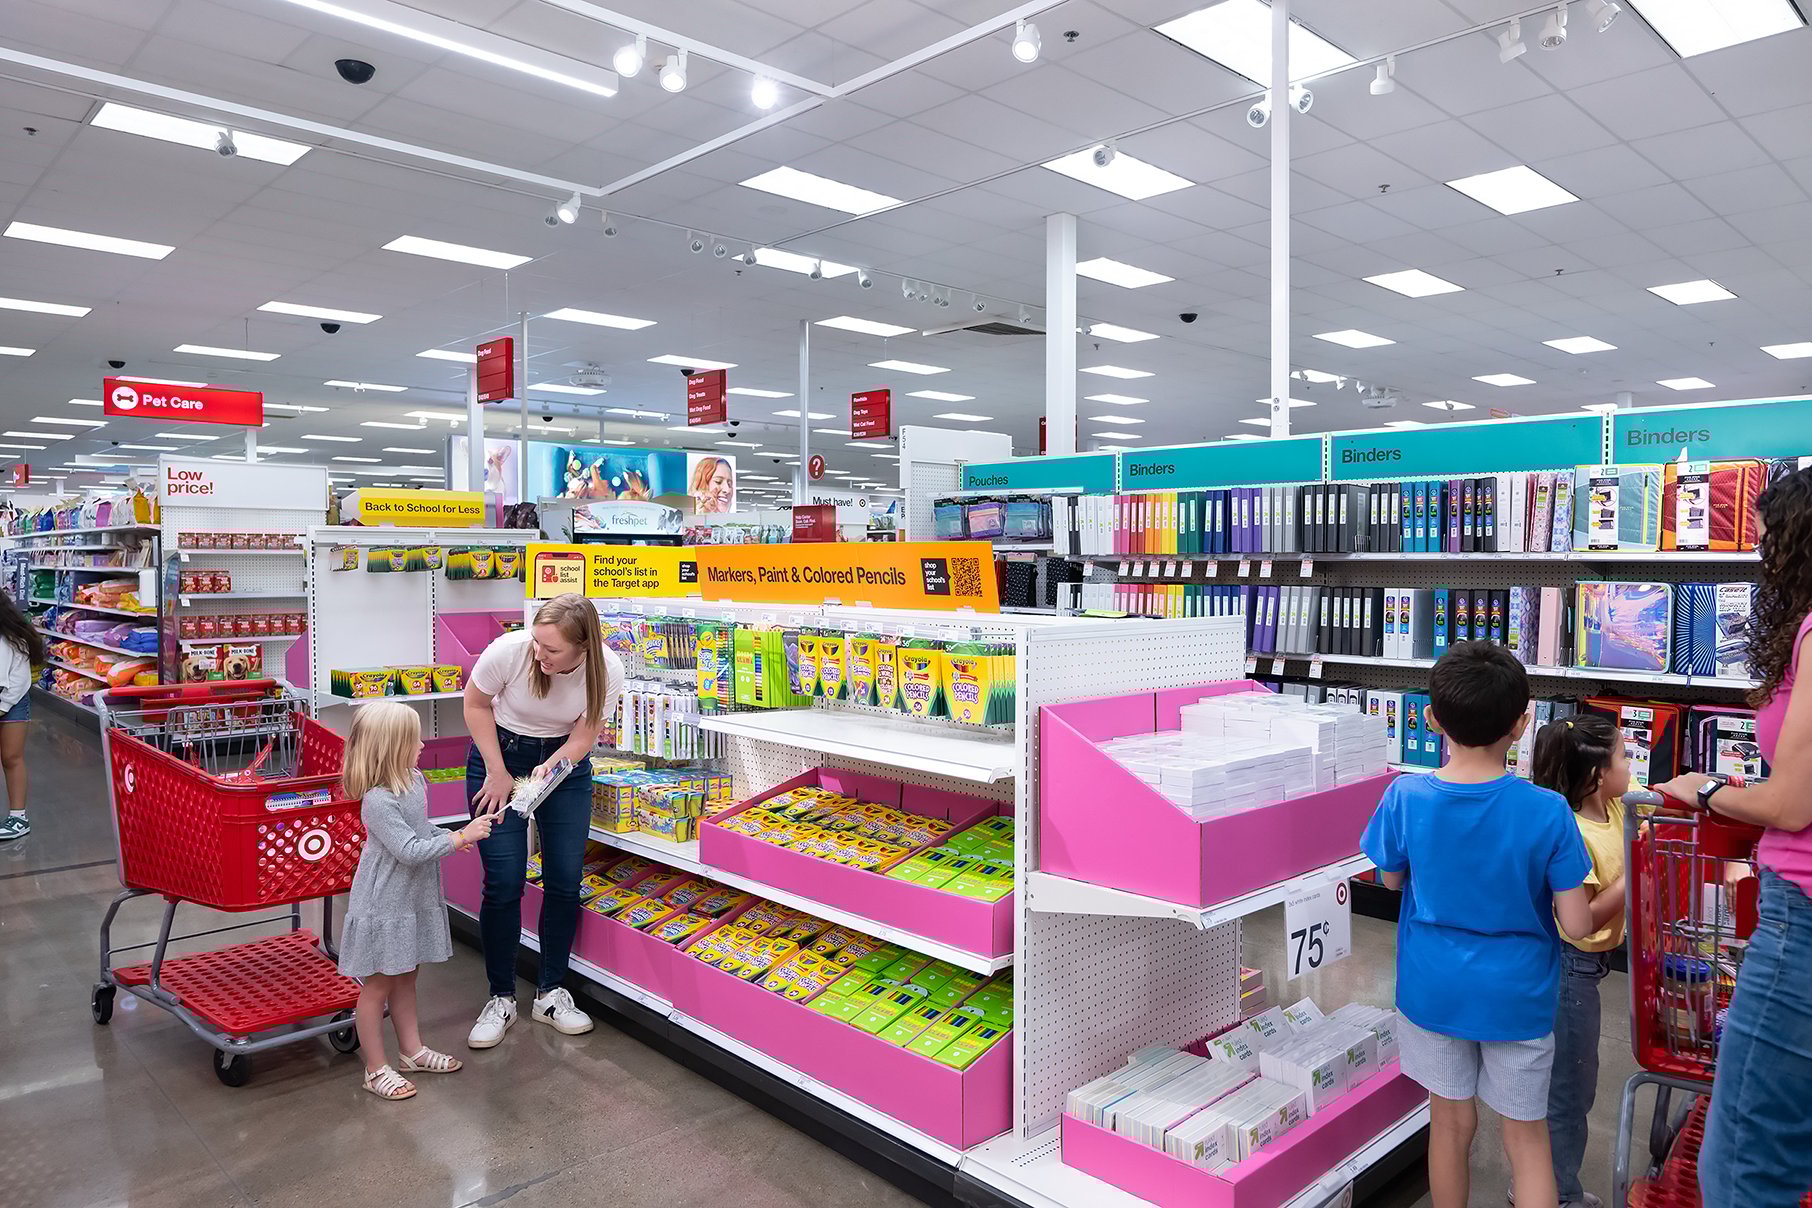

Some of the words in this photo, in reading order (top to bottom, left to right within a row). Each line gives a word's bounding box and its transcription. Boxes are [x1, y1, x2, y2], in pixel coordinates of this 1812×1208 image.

[143, 394, 167, 407] Pet
[170, 397, 204, 410] Care
[1627, 428, 1711, 447] Binders
[1342, 447, 1402, 464] Binders
[167, 467, 203, 481] Low
[1130, 462, 1175, 476] Binders
[969, 474, 1009, 487] Pouches
[167, 482, 214, 496] price!
[813, 496, 832, 505] Must
[833, 498, 852, 507] have!
[365, 502, 391, 512] Back
[394, 504, 404, 512] to
[406, 503, 442, 514] School
[443, 504, 456, 514] for
[458, 505, 480, 515] Less
[612, 515, 648, 527] freshpet
[594, 555, 614, 565] Find
[616, 556, 638, 566] your
[924, 562, 937, 570] shop
[594, 566, 632, 576] school's
[634, 567, 648, 577] list
[650, 568, 658, 577] in
[707, 566, 757, 584] Markers,
[758, 566, 790, 582] Paint
[791, 568, 802, 582] &
[803, 566, 854, 584] Colored
[856, 566, 906, 586] Pencils
[594, 579, 608, 588] the
[611, 578, 640, 589] Target
[642, 580, 660, 590] app
[926, 576, 946, 584] school's
[904, 655, 928, 663] Crayola
[904, 683, 930, 692] COLORED
[952, 683, 980, 694] COLORED
[906, 690, 930, 702] PENCILS
[954, 692, 978, 704] PENCILS
[1291, 920, 1330, 975] 75¢
[1261, 1021, 1273, 1031] index
[1264, 1028, 1276, 1038] cards
[1236, 1044, 1249, 1054] index
[1355, 1050, 1366, 1060] index
[1240, 1050, 1252, 1061] cards
[1355, 1057, 1366, 1068] cards
[1322, 1071, 1334, 1082] index
[1322, 1078, 1334, 1090] cards
[1205, 1141, 1218, 1153] index
[1205, 1148, 1218, 1161] cards
